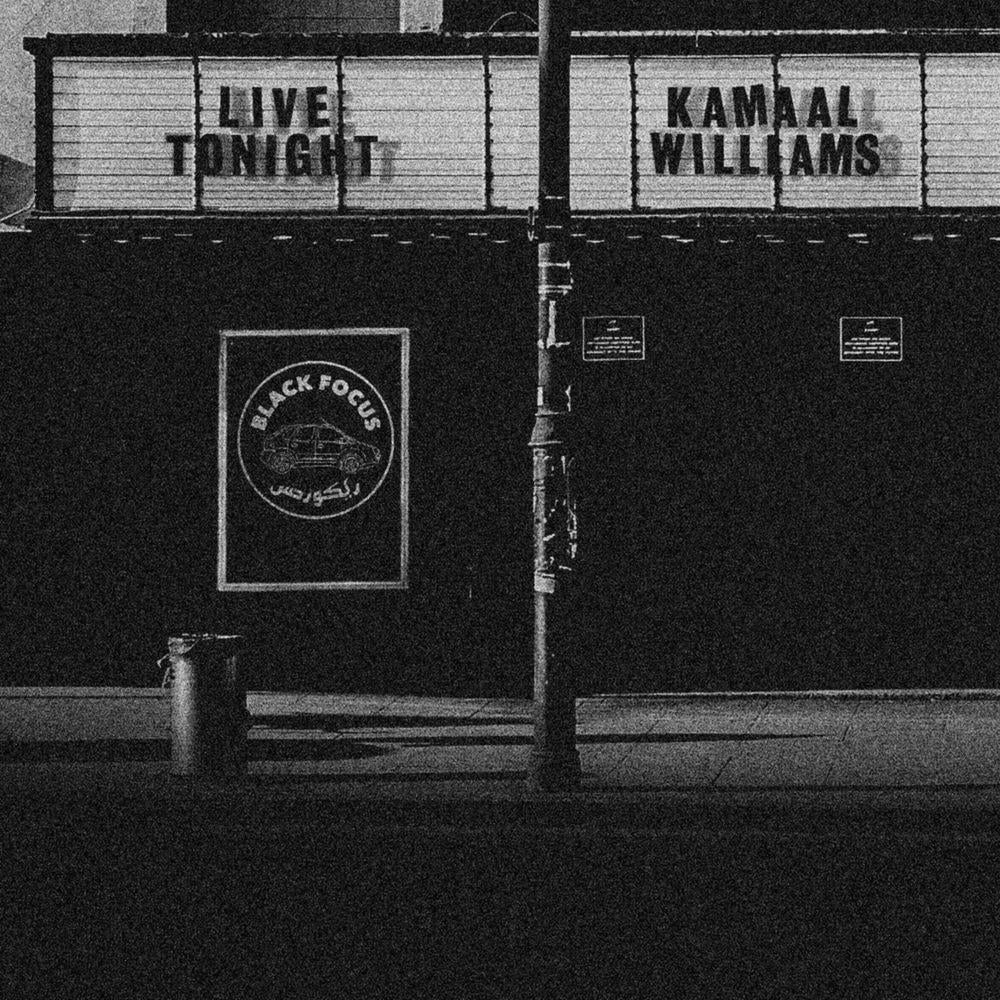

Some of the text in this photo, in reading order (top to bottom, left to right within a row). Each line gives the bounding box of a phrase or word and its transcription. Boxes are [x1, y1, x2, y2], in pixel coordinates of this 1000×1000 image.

[218, 85, 331, 128] LIVE
[667, 84, 858, 128] KAMAAL
[165, 132, 379, 177] TONIGHT
[650, 132, 881, 177] WILLIAMS
[250, 374, 381, 431] BLACK FOCUS
